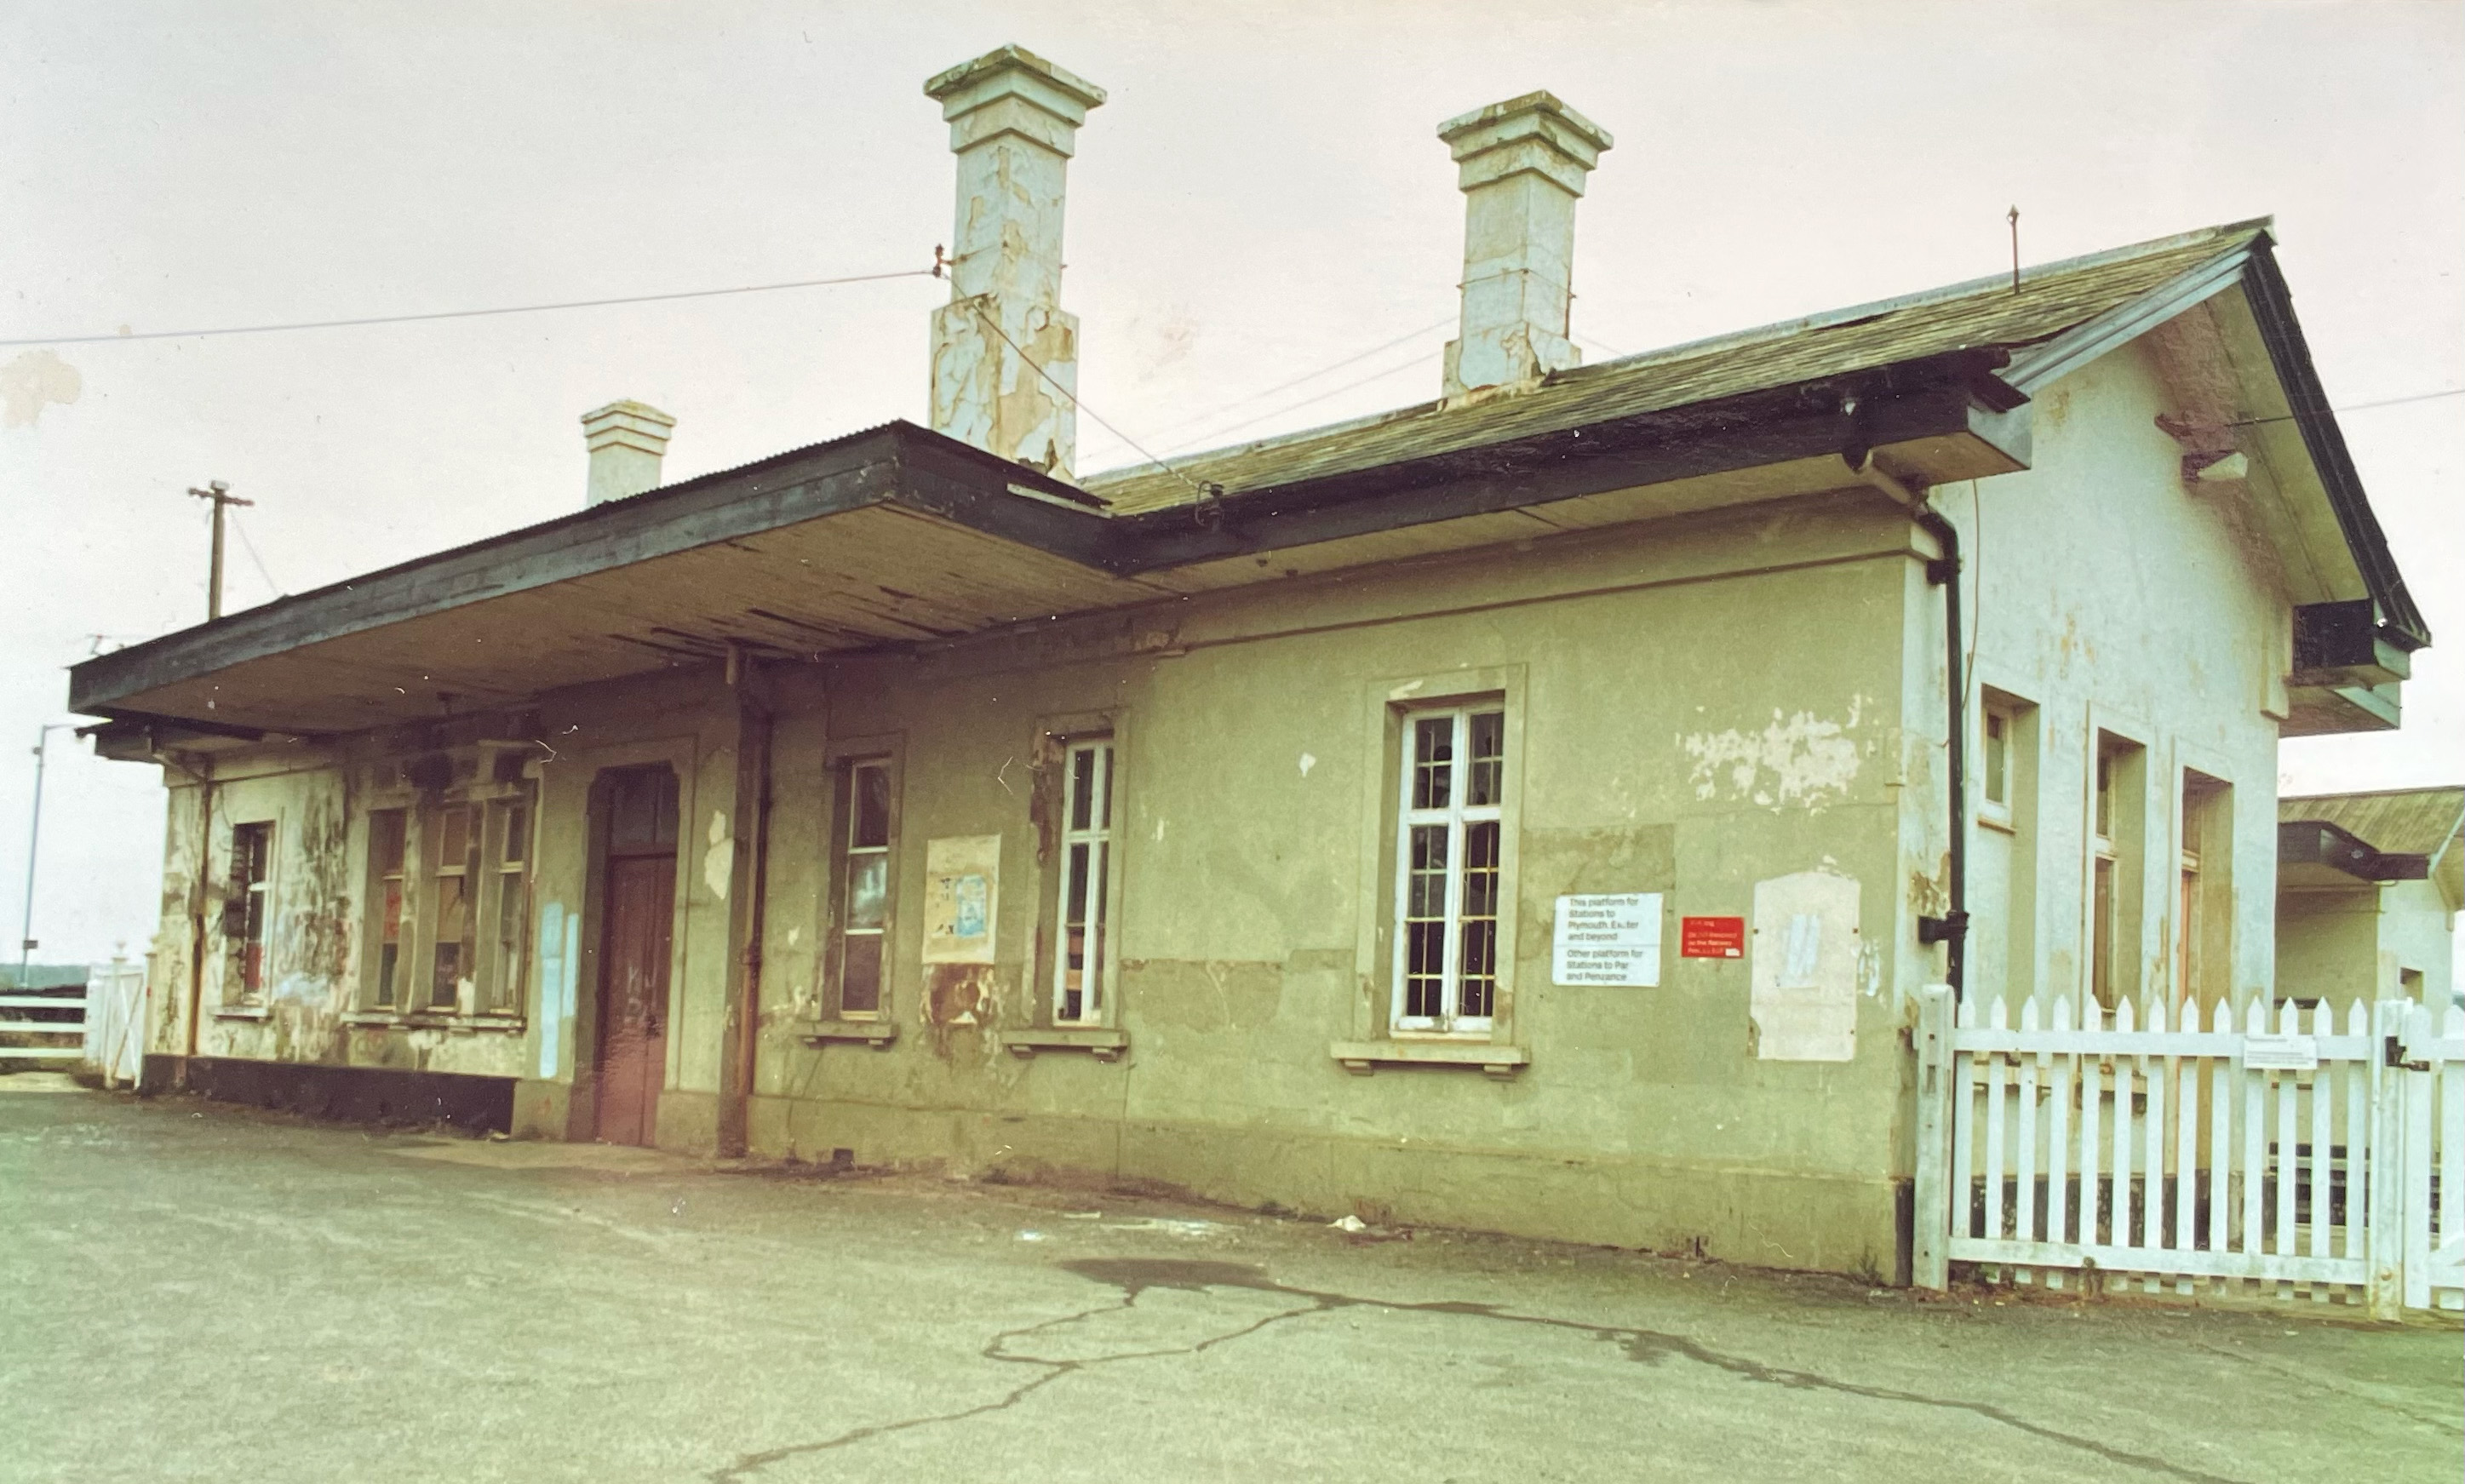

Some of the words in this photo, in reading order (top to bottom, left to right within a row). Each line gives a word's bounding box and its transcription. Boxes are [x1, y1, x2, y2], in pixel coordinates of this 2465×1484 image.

[1588, 898, 1625, 907] platform
[1626, 897, 1638, 905] for
[1568, 909, 1604, 918] Stations
[1607, 909, 1615, 918] to
[1592, 949, 1629, 958] platform
[1567, 960, 1602, 969] Stations
[1614, 960, 1628, 969] Par
[1585, 972, 1627, 981] Penzance
